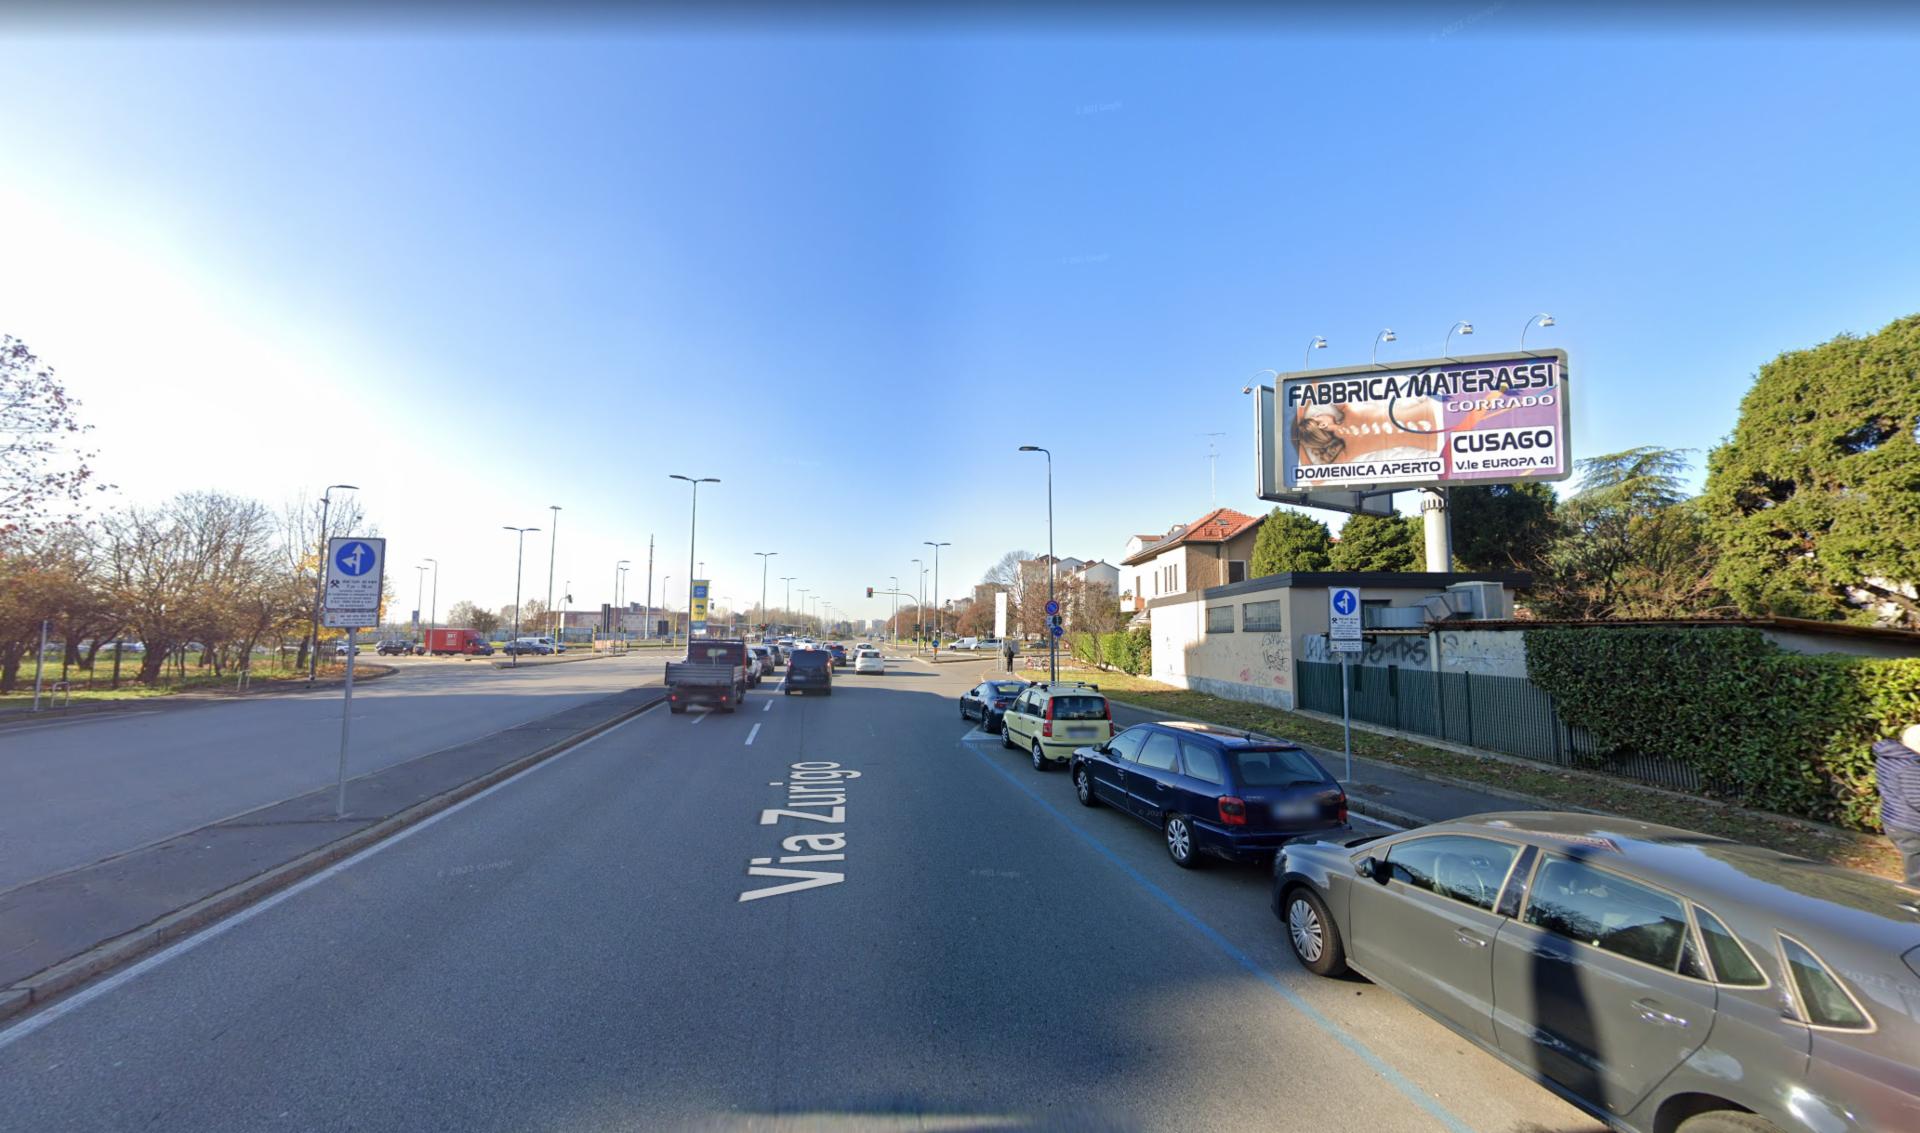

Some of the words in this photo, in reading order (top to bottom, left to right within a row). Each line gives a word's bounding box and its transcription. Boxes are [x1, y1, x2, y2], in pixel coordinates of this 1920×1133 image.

[1288, 377, 1401, 407] FABBRICA
[1406, 364, 1554, 398] MATERASSI
[1447, 394, 1554, 413] CORRADO
[1453, 430, 1553, 454] CUSAGO
[1295, 464, 1376, 479] DOMENICA
[1380, 461, 1441, 475] APERTO
[1456, 460, 1479, 470] V.le
[1482, 457, 1537, 469] EUROPA
[1540, 456, 1554, 466] 41
